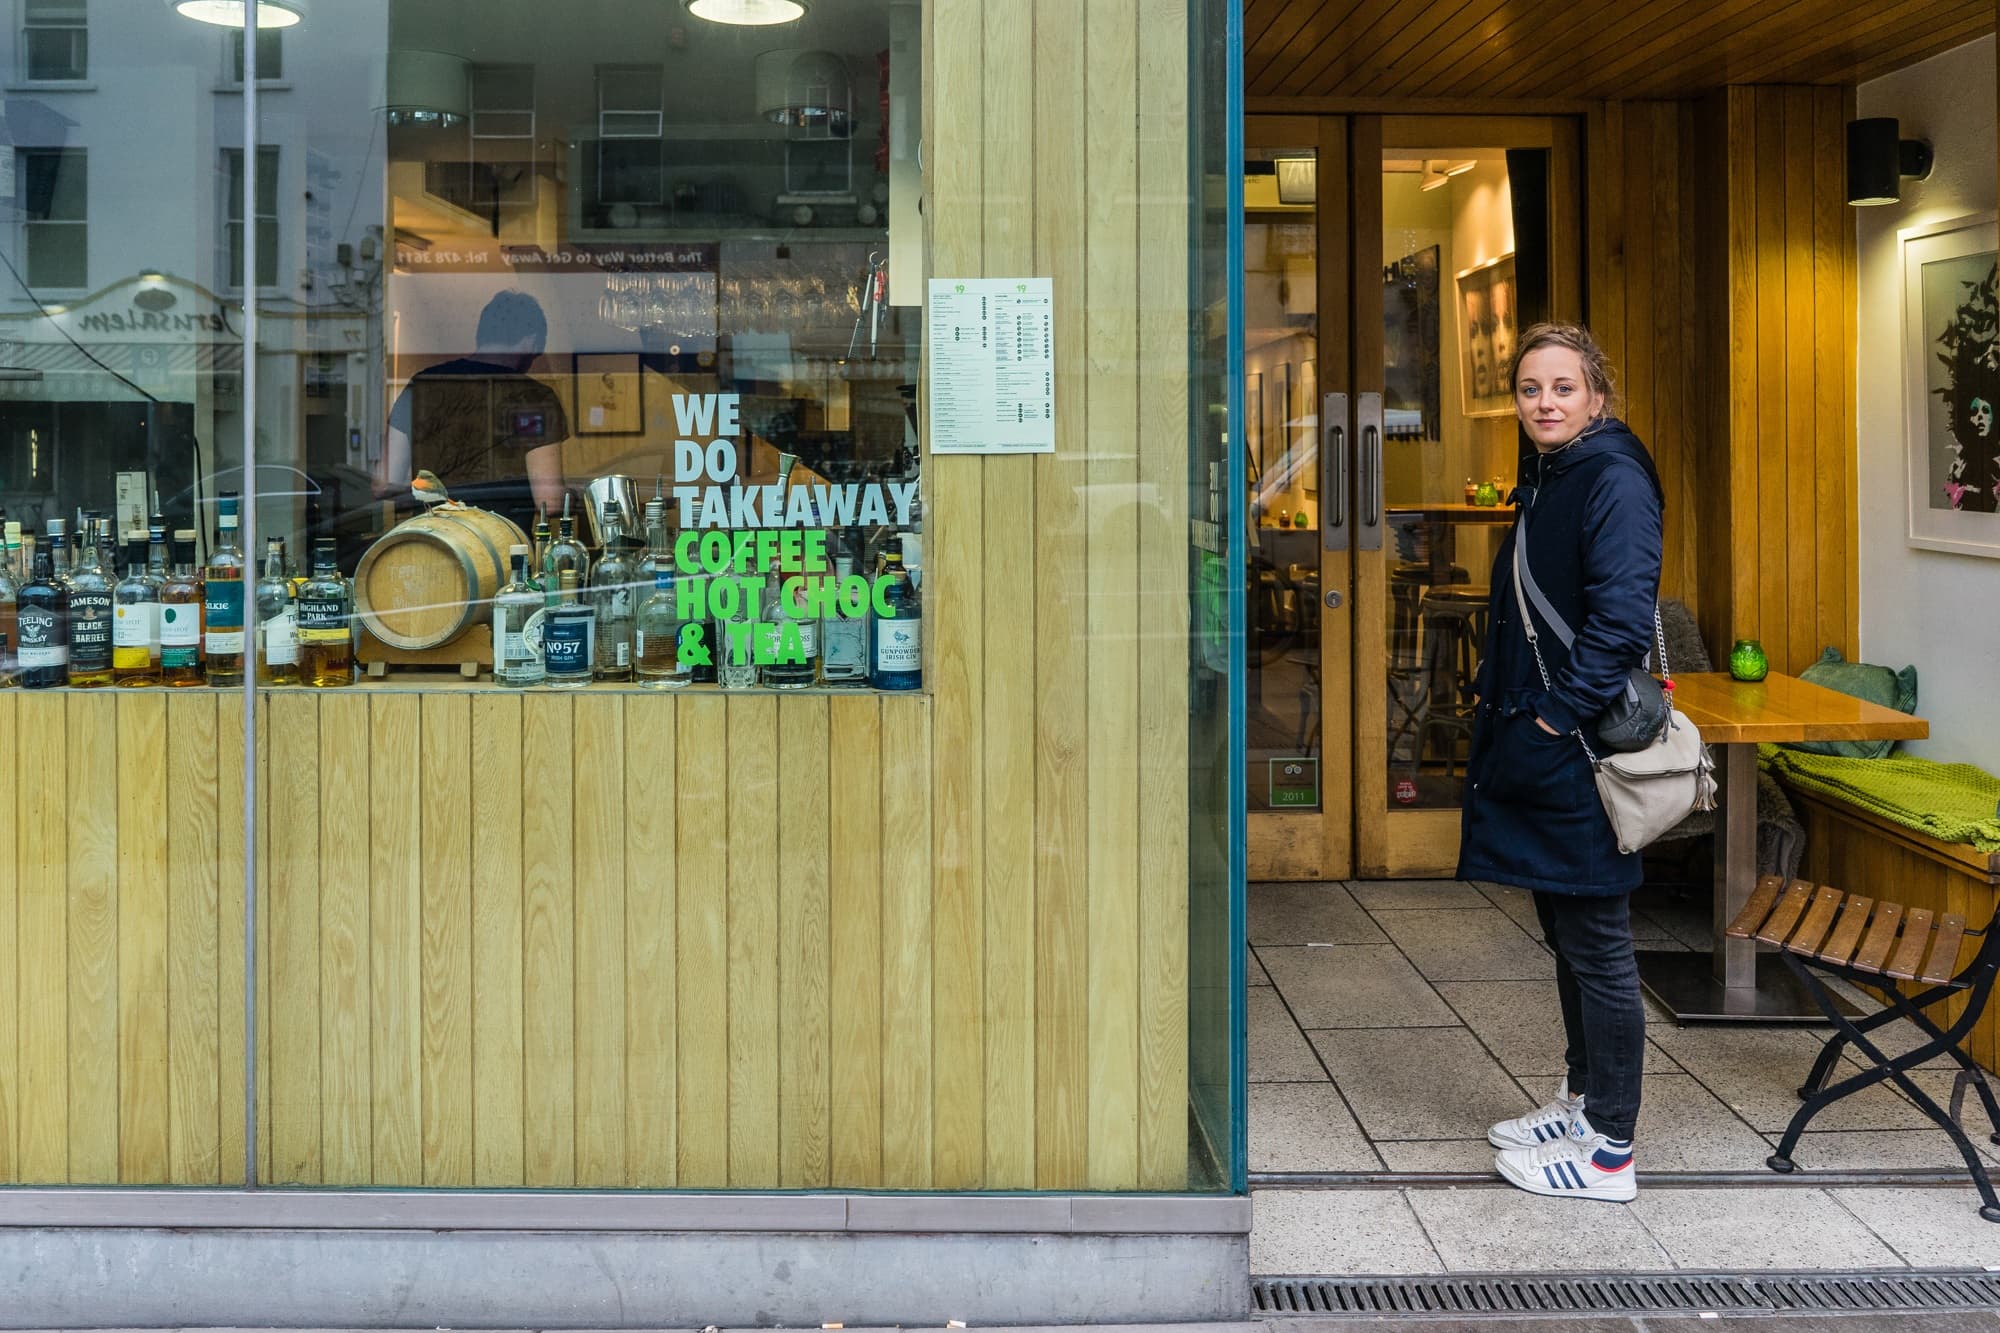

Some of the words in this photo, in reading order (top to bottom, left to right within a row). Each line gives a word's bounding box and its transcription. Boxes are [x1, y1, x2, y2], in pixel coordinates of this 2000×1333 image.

[955, 285, 965, 295] 19
[1016, 283, 1027, 294] 19
[672, 393, 740, 436] WE
[674, 439, 737, 483] DO
[672, 483, 918, 528] TAKEAWAY
[674, 530, 827, 574] COFFEE
[70, 597, 110, 608] JAMESON
[676, 576, 766, 620] HOT
[780, 575, 896, 618] CHOC
[299, 603, 338, 612] HIGHLAND
[18, 616, 53, 628] TEELING
[307, 612, 327, 621] PARK
[77, 621, 103, 630] BLACK
[75, 633, 106, 643] BARREL
[677, 623, 713, 666] &
[726, 623, 807, 665] TEA
[1283, 792, 1304, 801] 2011
